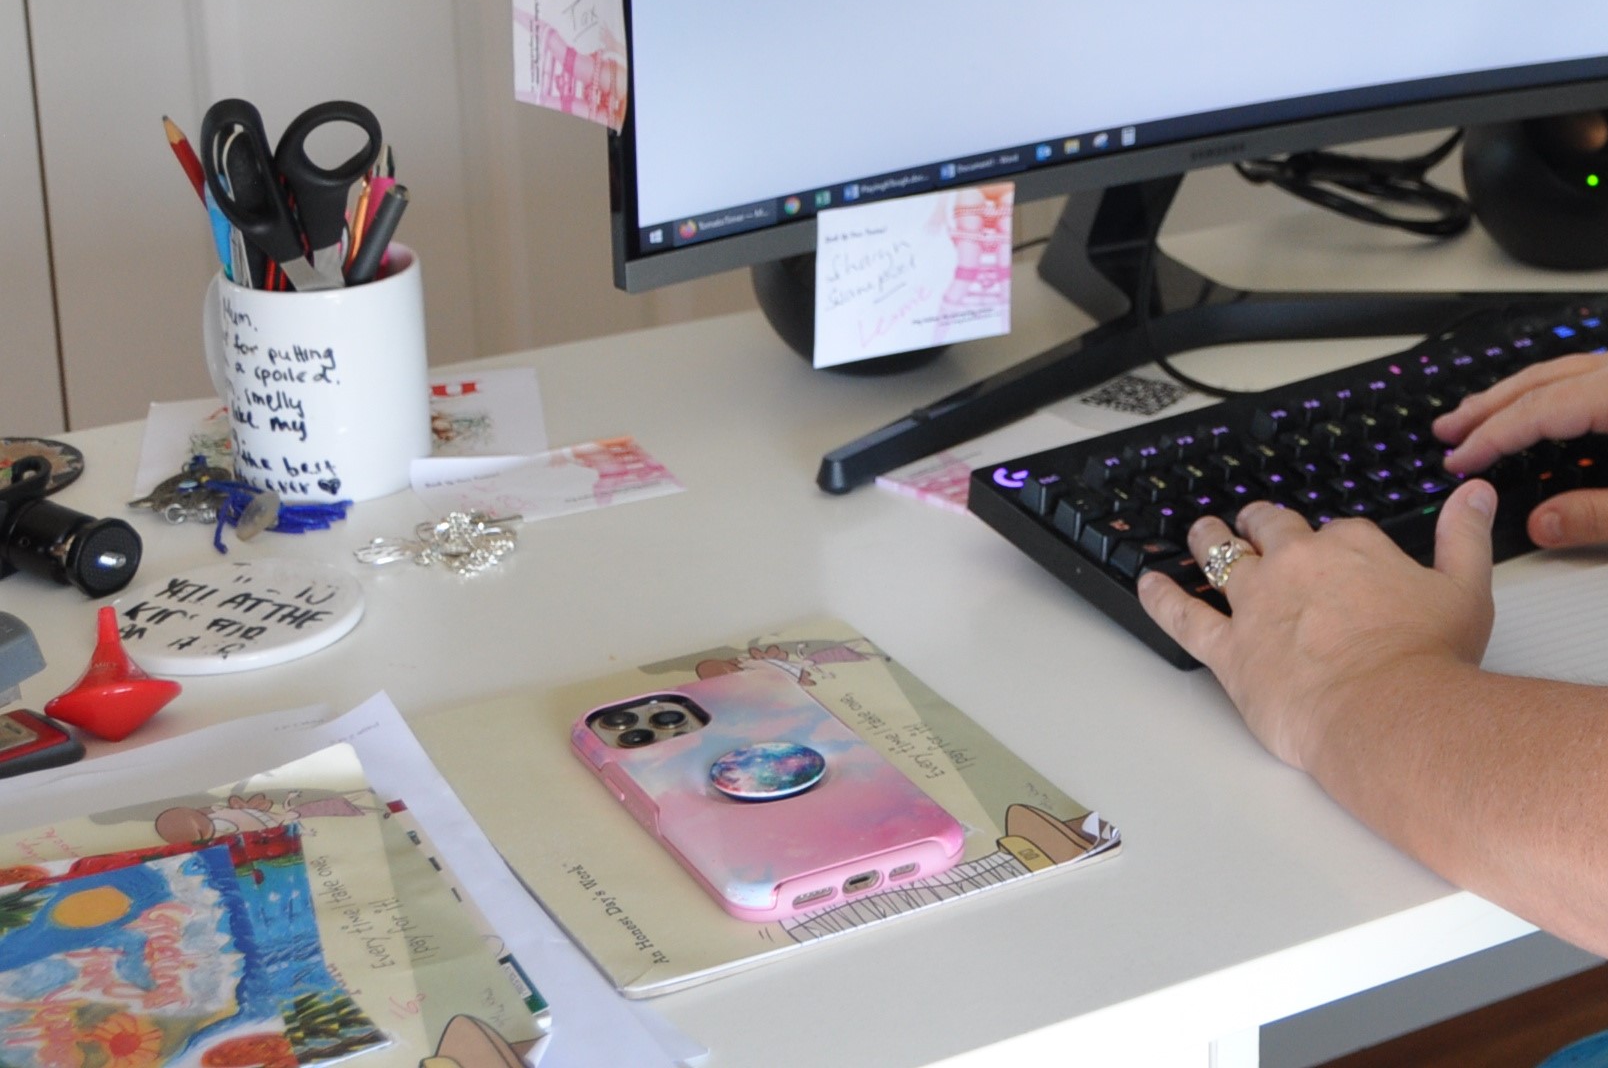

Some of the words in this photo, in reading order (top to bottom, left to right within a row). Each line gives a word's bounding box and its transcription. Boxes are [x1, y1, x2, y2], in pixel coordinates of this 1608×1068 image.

[234, 334, 259, 355] for
[268, 345, 336, 371] putting
[270, 417, 307, 441] my
[283, 456, 338, 477] best
[857, 711, 886, 736] take
[885, 731, 912, 754] time
[927, 734, 950, 751] for
[912, 749, 946, 780] Every
[566, 863, 598, 891] Work
[318, 879, 352, 904] take
[592, 890, 624, 917] Day's
[341, 908, 374, 935] time
[386, 915, 418, 936] for
[617, 916, 655, 951] Honest
[360, 936, 396, 969] Every
[404, 934, 440, 955] pay
[652, 950, 670, 965] An
